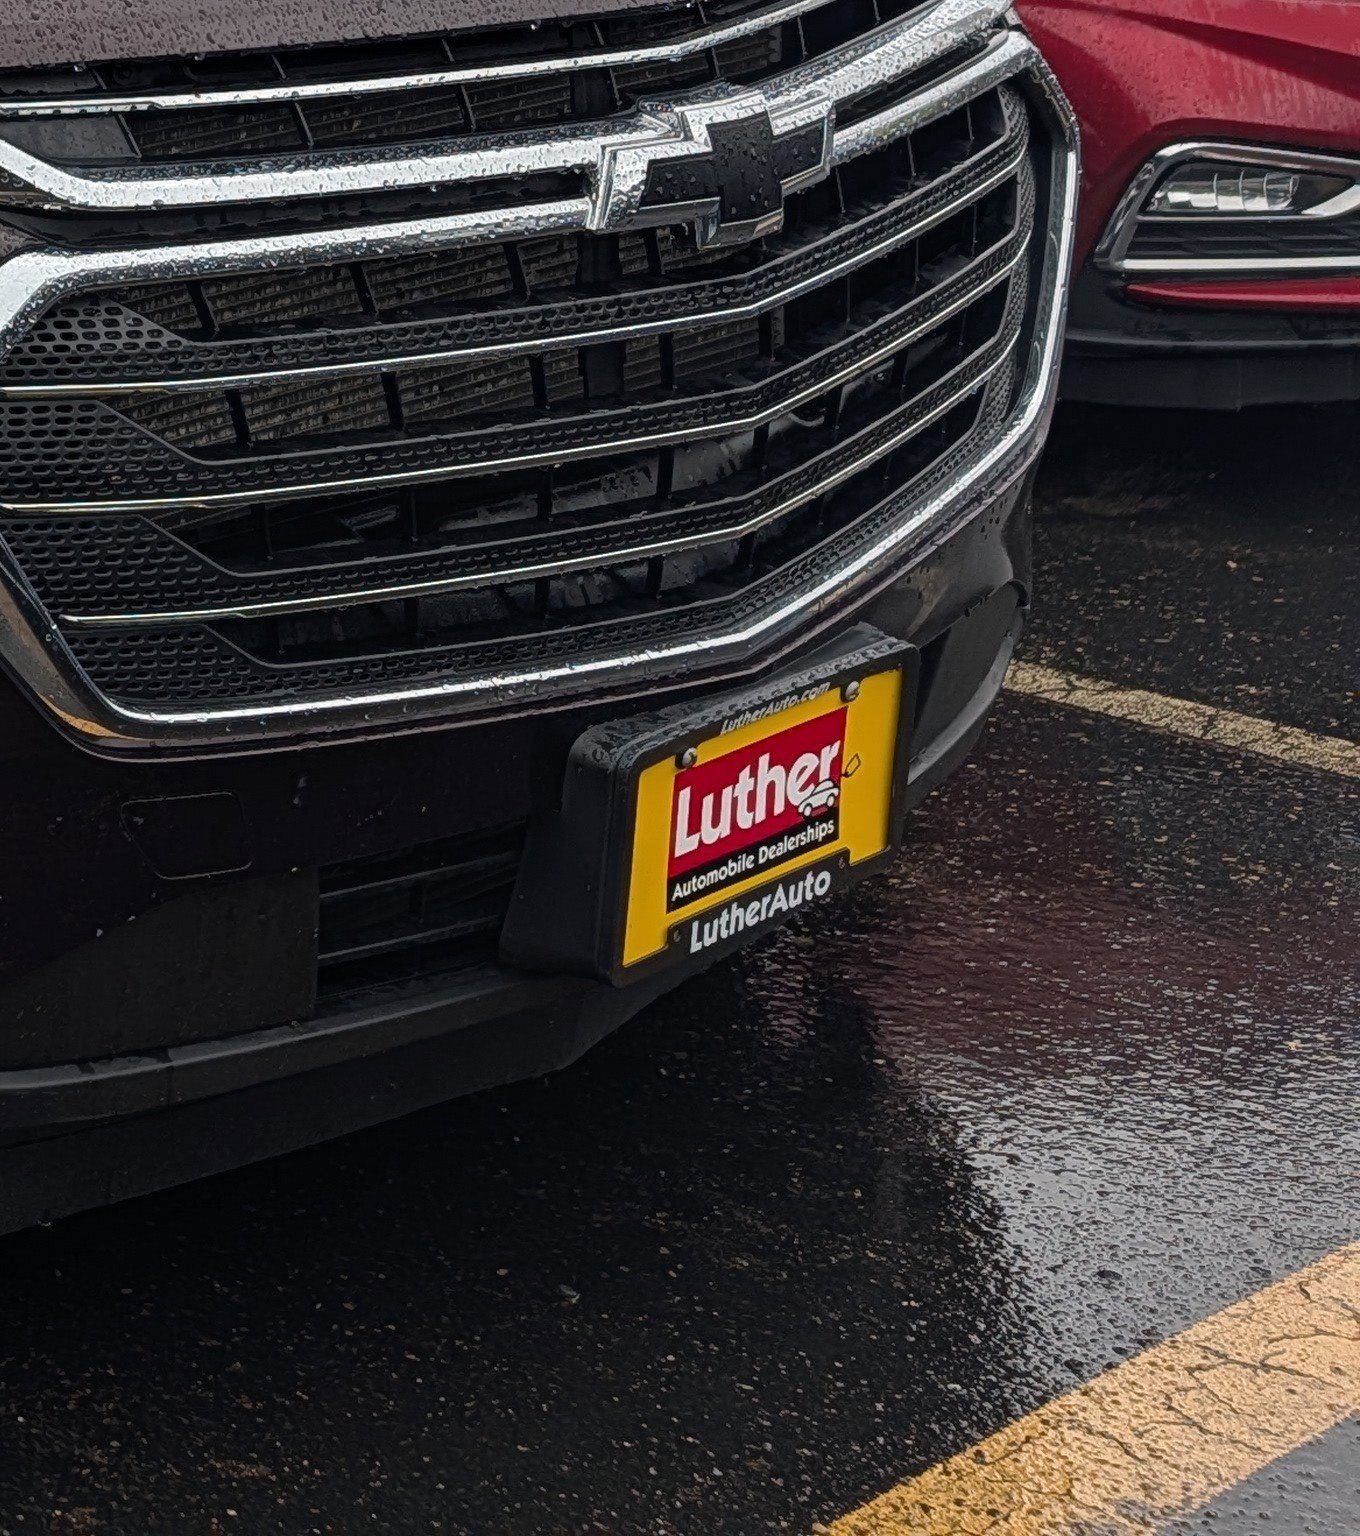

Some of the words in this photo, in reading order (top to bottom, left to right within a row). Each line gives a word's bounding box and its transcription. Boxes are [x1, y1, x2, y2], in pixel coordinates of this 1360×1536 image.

[720, 682, 831, 735] LutherAuto.com
[675, 740, 842, 858] Luther
[671, 851, 755, 901] Automobile
[758, 819, 835, 862] Dealerships
[690, 869, 832, 955] LutherAuto
